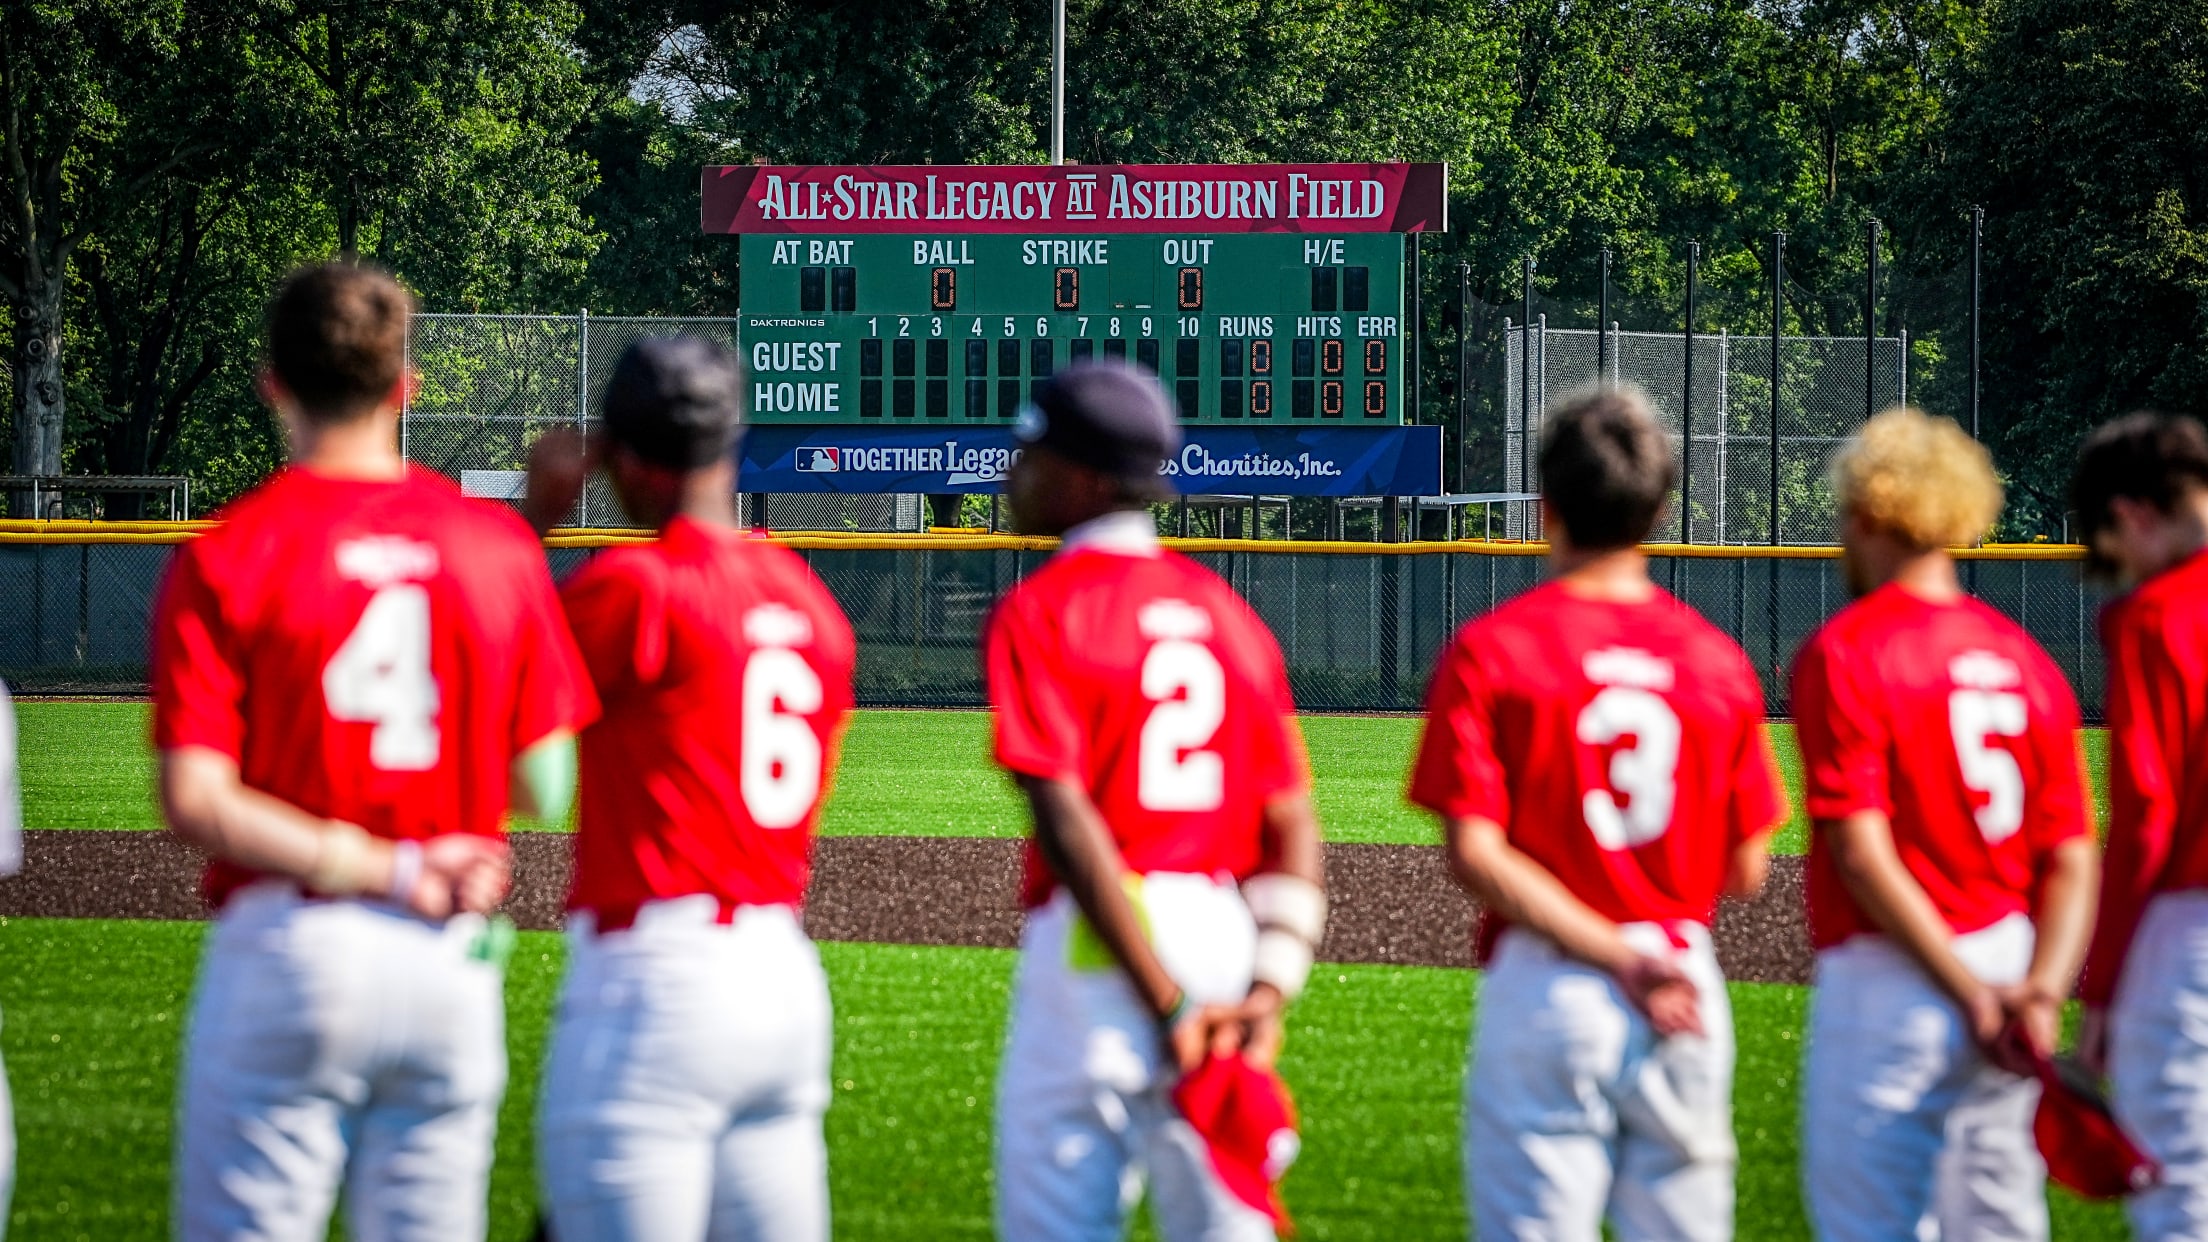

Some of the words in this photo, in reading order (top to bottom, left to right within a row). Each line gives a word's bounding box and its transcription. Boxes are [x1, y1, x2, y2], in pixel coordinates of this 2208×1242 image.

[926, 175, 1056, 219] LEGACY
[1067, 181, 1096, 211] AT
[1107, 175, 1277, 219] ASHBURN
[1288, 174, 1383, 218] FIELD
[773, 241, 801, 264] AT
[810, 241, 853, 264] BAT
[914, 241, 974, 264] BALL
[1023, 240, 1107, 264] STRIKE
[1164, 240, 1213, 264] OUT
[1304, 240, 1344, 266] H/E
[934, 269, 953, 307] 0
[1057, 269, 1076, 307] 0
[1180, 269, 1200, 307] 0
[750, 319, 825, 327] DAKTRONICS
[869, 318, 876, 336] 1
[899, 317, 910, 336] 2
[932, 317, 941, 336] 3
[972, 318, 982, 336] 4
[1005, 317, 1014, 336] 5
[1037, 318, 1047, 336] 6
[1078, 317, 1088, 336] 7
[1110, 318, 1119, 336] 8
[1142, 317, 1151, 336] 9
[1178, 317, 1198, 336] 10
[1220, 317, 1273, 336] RUNS
[1298, 317, 1341, 336] HITS
[1359, 317, 1396, 336] ERR
[754, 342, 841, 371] GUEST
[1253, 341, 1269, 371] 0
[1324, 341, 1341, 372] 0
[1367, 341, 1383, 371] 0
[756, 383, 839, 411] HOME
[1253, 383, 1269, 413] 0
[1324, 383, 1340, 413] 0
[1367, 383, 1383, 413] 0
[842, 448, 942, 471] TOGETHER
[946, 442, 1024, 478] Legac
[324, 584, 437, 768] 4
[742, 646, 828, 832] 6
[1139, 640, 1224, 810] 2
[1578, 687, 1679, 849] 3
[1950, 690, 2026, 838] 5
